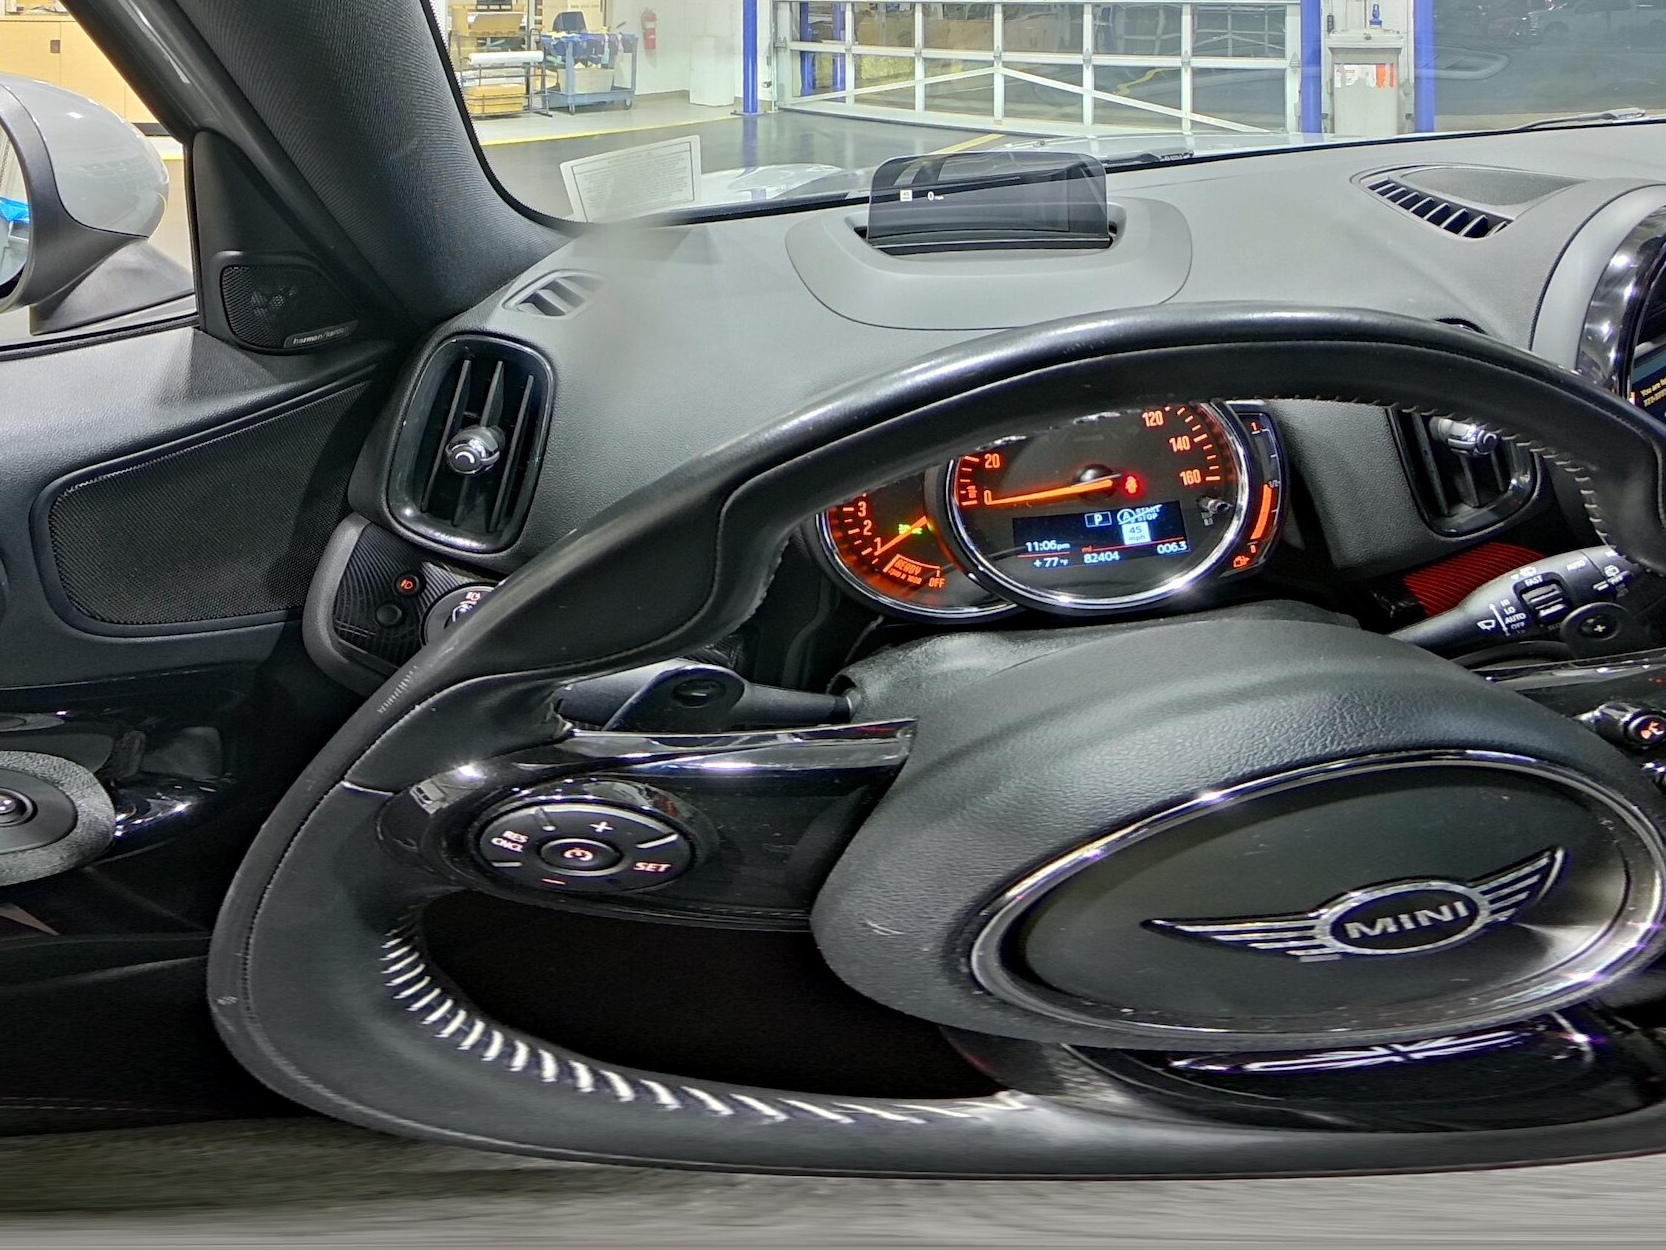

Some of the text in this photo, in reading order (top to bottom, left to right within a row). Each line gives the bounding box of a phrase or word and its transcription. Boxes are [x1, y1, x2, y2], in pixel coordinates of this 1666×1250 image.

[1142, 410, 1164, 427] 120
[1169, 435, 1191, 452] 140
[984, 453, 1000, 469] 20
[1179, 468, 1202, 486] 160
[983, 489, 993, 505] 0
[857, 501, 867, 517] 3
[863, 519, 872, 535] 2
[1129, 525, 1143, 534] 45
[874, 537, 882, 551] 1
[1128, 534, 1146, 542] mph
[1156, 541, 1188, 555] 006.3
[1083, 551, 1120, 564] 82404
[928, 577, 946, 589] OFF
[1524, 575, 1544, 587] FAST
[1503, 607, 1516, 615] LO
[1505, 613, 1527, 625] AUTO
[1511, 621, 1526, 630] OFF
[502, 830, 530, 844] RES
[490, 837, 524, 853] CNCL
[634, 861, 672, 872] SET
[1343, 901, 1470, 939] MINI
